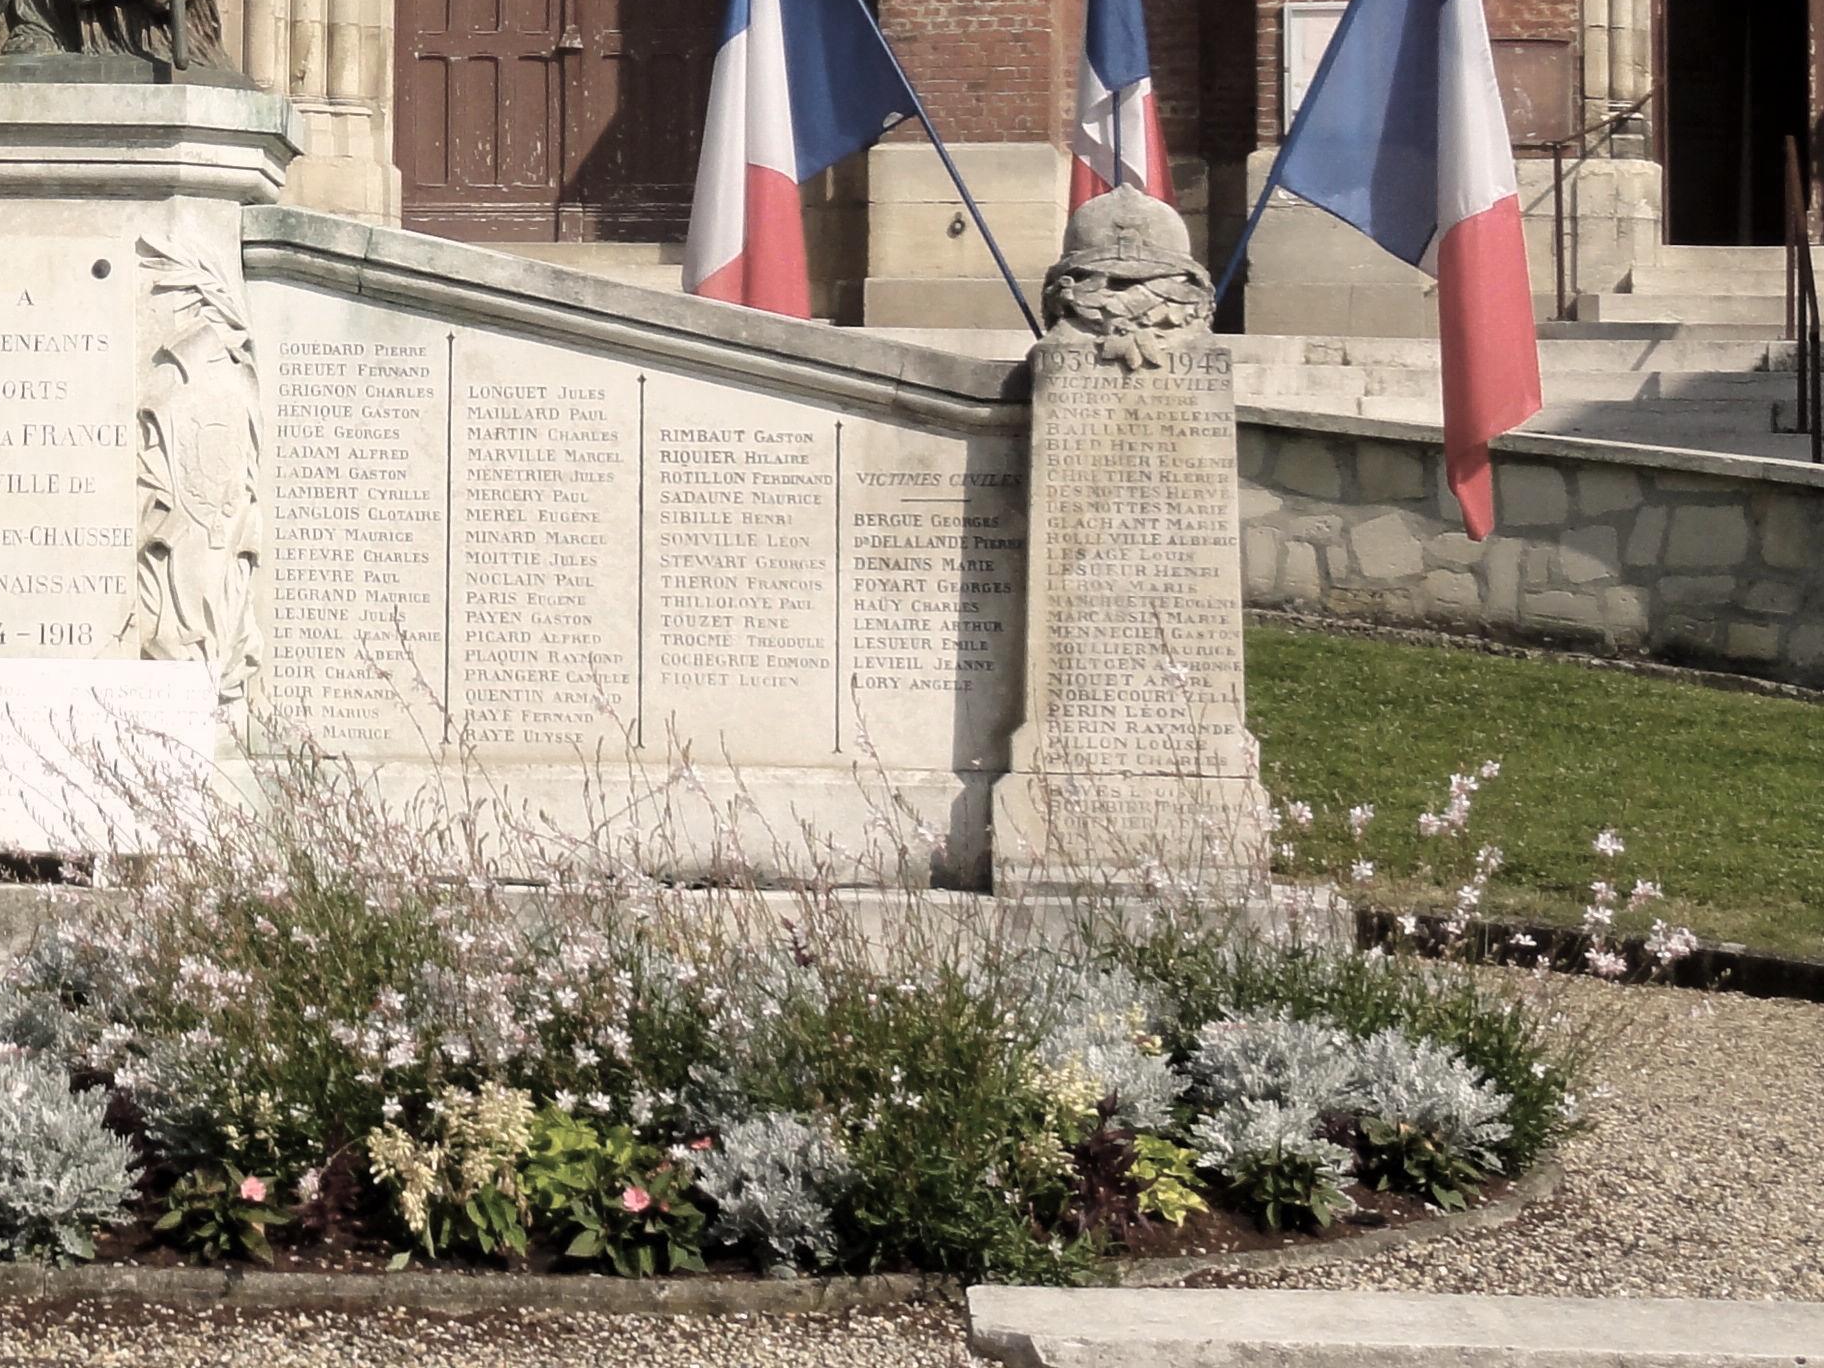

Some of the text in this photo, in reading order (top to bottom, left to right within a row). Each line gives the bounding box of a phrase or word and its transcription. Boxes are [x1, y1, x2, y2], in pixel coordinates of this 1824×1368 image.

[17, 289, 34, 306] A
[1, 334, 110, 352] ENFANTS
[375, 344, 427, 357] PIERRE
[279, 363, 430, 377] GREUET FERNAND
[1168, 352, 1231, 375] 1945
[279, 384, 434, 398] GRIGNON CHARLES
[1153, 378, 1231, 391] CIVILES
[469, 386, 605, 400] LONGUET JULES
[362, 406, 420, 419] GASTON
[467, 407, 607, 421] MAILLARD PAUL
[22, 424, 127, 446] FRANCE
[334, 426, 400, 439] GEORGES
[467, 428, 618, 441] MARTIN CHARLES
[660, 430, 813, 443] RIMBAUT GASTON
[277, 446, 409, 460] LADAM ALFRED
[660, 450, 809, 467] RIQUIER HILAIRE
[69, 477, 96, 494] DE
[857, 472, 1023, 487] VICTIMES CIVILES
[276, 486, 430, 500] LAMBERT CYRILLE
[660, 491, 822, 505] SADAUNE MAURICE
[275, 506, 441, 521] LANGLOIS CLOTAIRE
[660, 511, 792, 525] SIBILLE HENRI
[854, 514, 1000, 528] BERGUE GEORGES
[275, 528, 413, 542] LARDY MAURICE
[465, 531, 607, 545] MINARD MARCEL
[660, 555, 825, 570] STEWART GEORGES
[854, 557, 995, 572] DENAINS MARIE
[854, 578, 1012, 594] FOYART GEORGES
[912, 600, 979, 613] CHARLES
[465, 611, 592, 625] PAYEN GASTON
[854, 618, 1003, 633] LEMAIRE ARTHUR
[40, 623, 92, 645] 1918
[465, 631, 601, 644] PICARD ALFRED
[854, 637, 989, 651] LESUEUR EMILE
